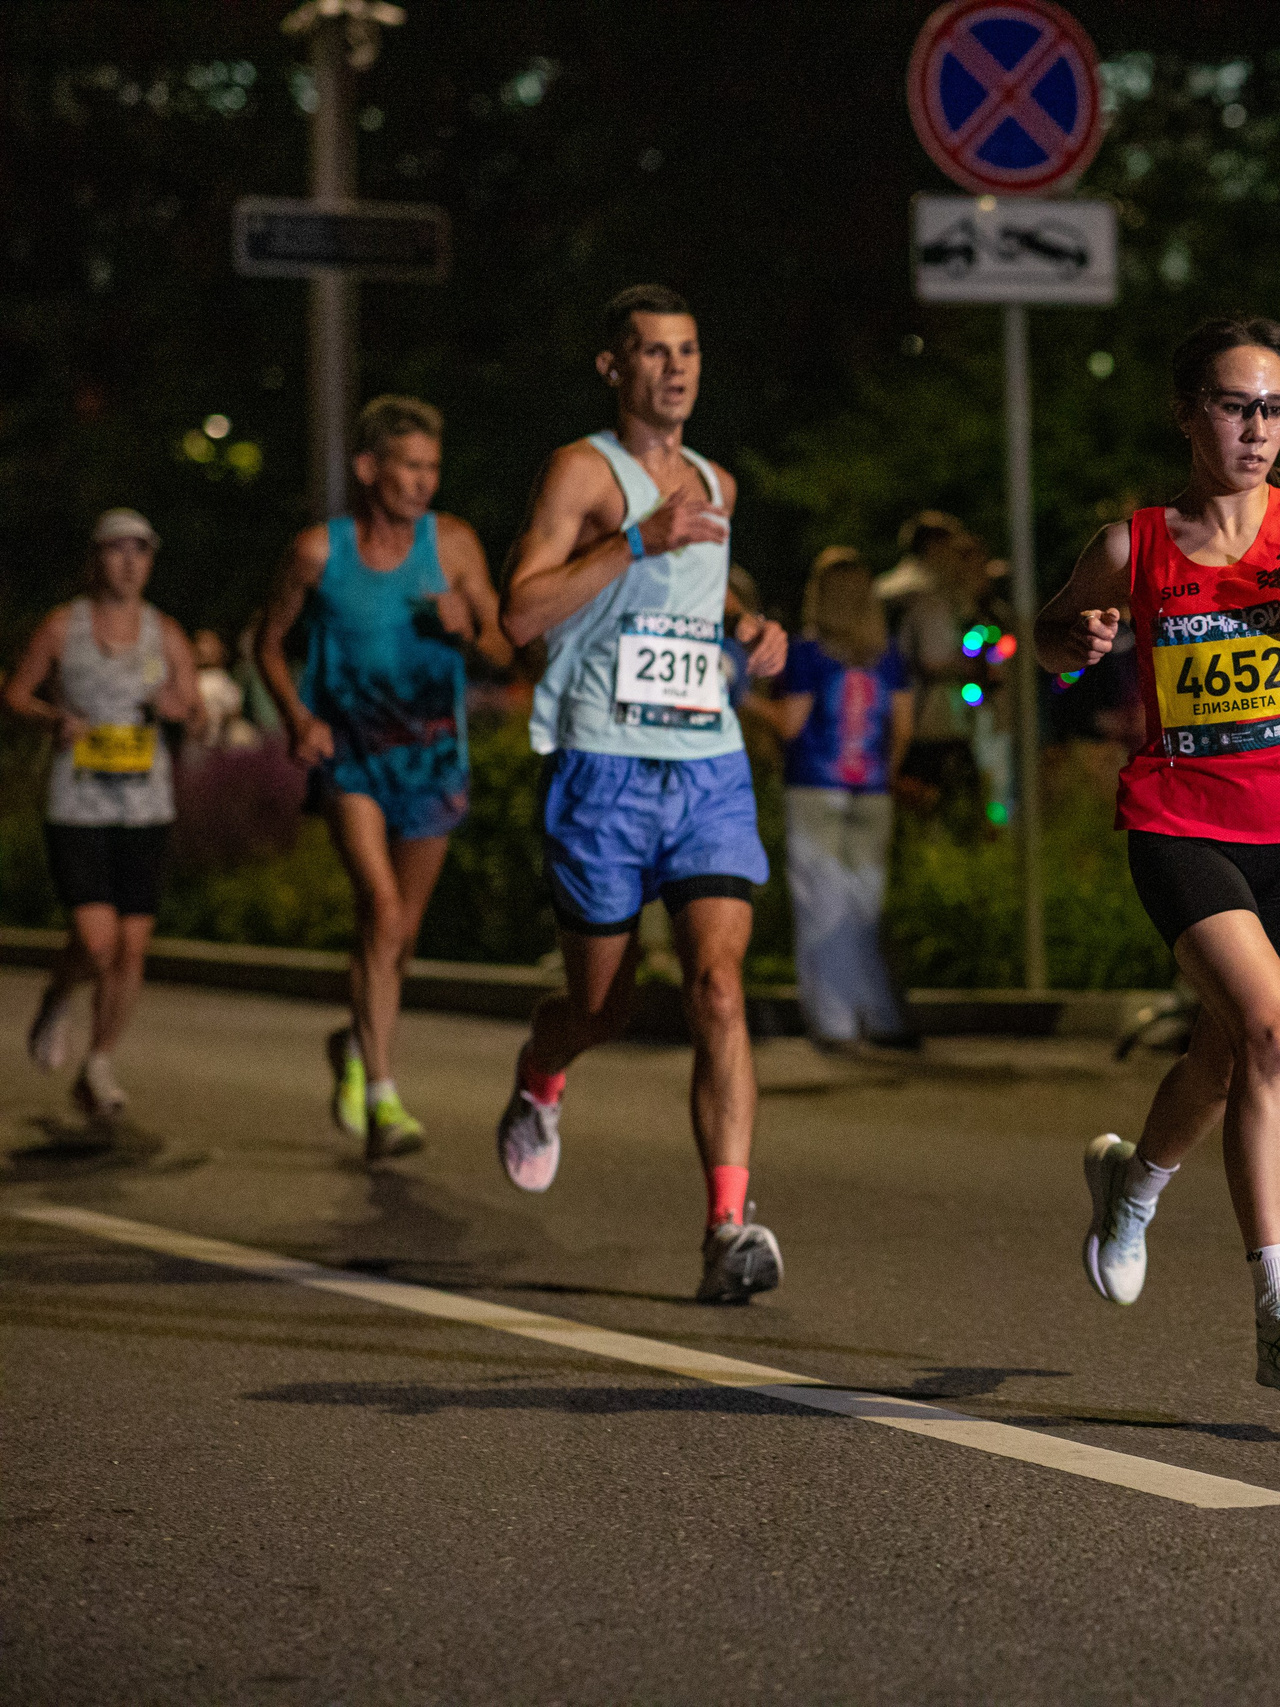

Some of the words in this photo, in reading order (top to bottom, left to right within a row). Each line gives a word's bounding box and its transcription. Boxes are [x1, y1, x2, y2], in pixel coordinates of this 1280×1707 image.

[1161, 582, 1200, 600] SUB
[636, 648, 708, 686] 2319
[1193, 695, 1276, 715] ЕЛИЗАВЕТА
